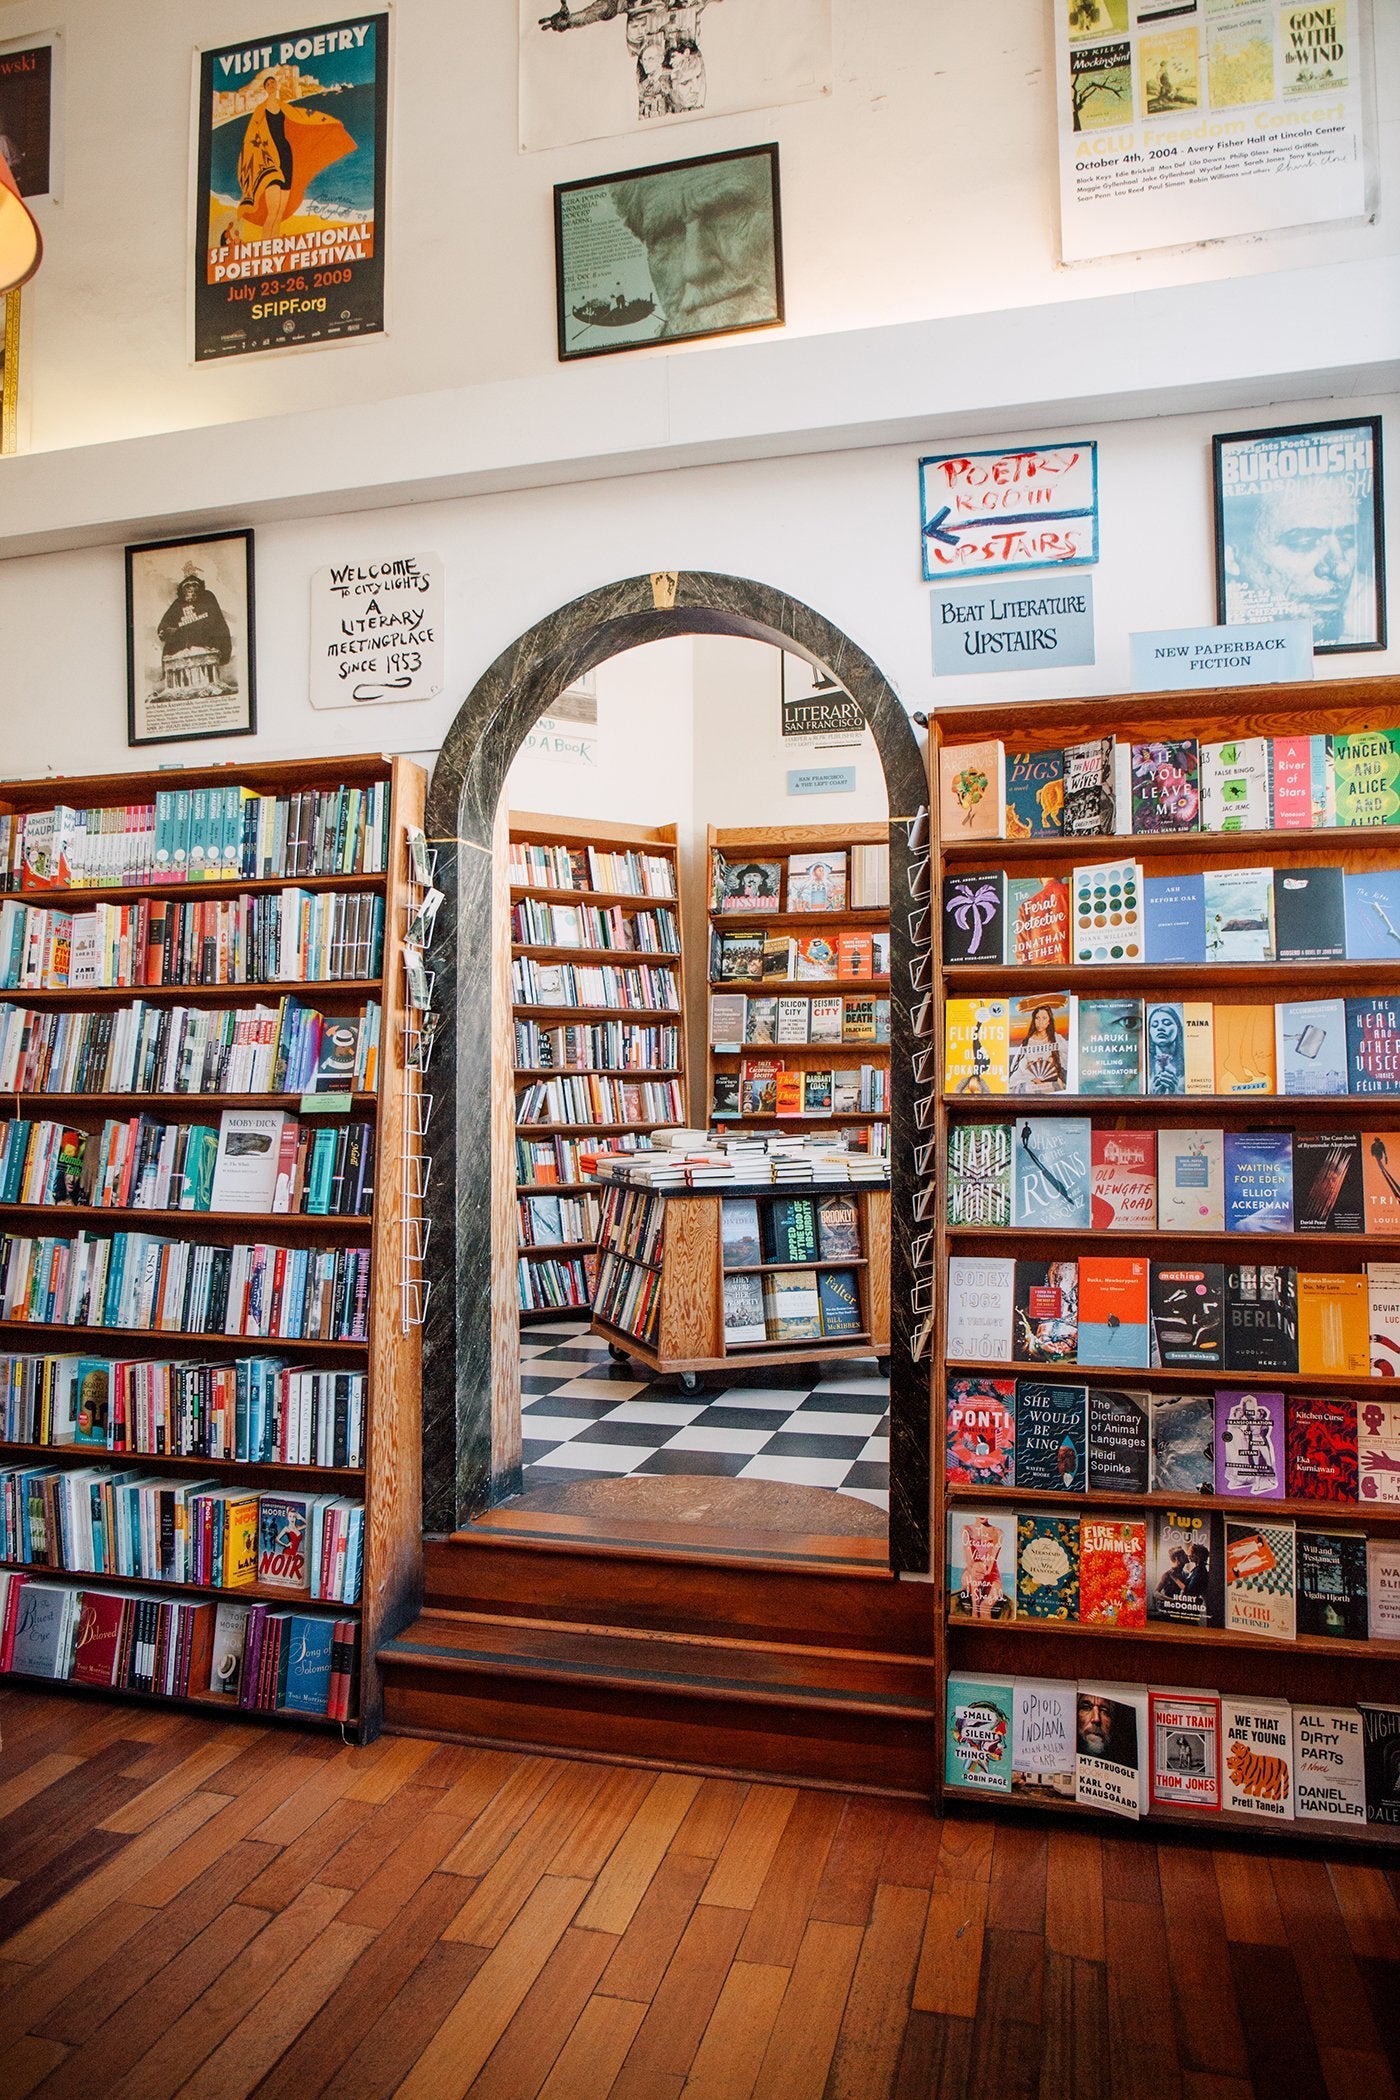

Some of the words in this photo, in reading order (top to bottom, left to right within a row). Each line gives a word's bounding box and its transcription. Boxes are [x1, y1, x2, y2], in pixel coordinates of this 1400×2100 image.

[1290, 8, 1336, 31] GONE
[1290, 26, 1336, 48] WITH
[219, 47, 273, 77] VISIT
[281, 26, 370, 65] POETRY
[1077, 51, 1088, 59] TO
[1092, 46, 1114, 57] KILL
[1285, 52, 1298, 64] the
[1297, 44, 1344, 65] WIND
[1073, 51, 1130, 71] Mockingbird
[1076, 134, 1135, 158] ACLU
[1143, 117, 1246, 149] Freedom
[1254, 102, 1345, 130] Concert
[1075, 158, 1120, 171] October
[1123, 153, 1145, 163] 4th,
[1149, 147, 1178, 160] 2004
[1187, 145, 1214, 154] Avery
[1217, 139, 1244, 149] Fisher
[1247, 132, 1266, 144] Hall
[1281, 128, 1312, 140] Lincoln
[1315, 126, 1346, 136] Center
[210, 246, 230, 265] SF
[234, 223, 371, 261] INTERNATIONAL
[215, 256, 286, 283] POETRY
[290, 242, 367, 271] FESTIVAL
[227, 284, 257, 303] July
[261, 277, 310, 297] 23-26,
[313, 269, 353, 289] 2009
[251, 297, 328, 321] SFIPF.org
[1280, 440, 1310, 448] Poets
[1223, 440, 1373, 484] BUKOWSKI
[936, 453, 1079, 488] POETRY
[956, 484, 1058, 512] ROOM
[934, 531, 1082, 566] UPSTAIRS
[330, 558, 420, 584] WELCOME
[355, 583, 382, 596] CITY
[384, 573, 431, 593] LIGHTS
[365, 598, 382, 616] A
[941, 603, 985, 625] BEAT
[990, 596, 1087, 621] LITERATURE
[341, 609, 425, 636] LITERARY
[328, 628, 435, 657] MEETINGPLACE
[963, 628, 1059, 656] UPSTAIRS
[1154, 646, 1189, 660] NEW
[1195, 638, 1287, 657] PAPERBACK
[338, 659, 377, 680] SINCE
[386, 652, 423, 673] 1953
[1190, 656, 1252, 671] FICTION
[785, 703, 862, 724] LITERARY
[785, 721, 804, 732] SAN
[806, 718, 863, 730] FRANCISCO
[1337, 740, 1395, 760] VINCENT
[1010, 760, 1060, 782] PIGS
[1082, 756, 1102, 770] NOT
[1233, 766, 1255, 775] BINGO
[1278, 761, 1305, 771] River
[1149, 767, 1182, 781] YOU
[1141, 783, 1192, 800] LEAVE
[1279, 787, 1306, 797] Stars
[1349, 778, 1387, 795] ALICE
[724, 896, 777, 909] MISSION
[1023, 894, 1058, 915] Feral
[1013, 912, 1066, 935] Detective
[1011, 931, 1066, 953] JONATHAN
[1021, 945, 1063, 962] LETHEM
[780, 1000, 806, 1008] SILICON
[846, 1002, 872, 1012] BLACK
[846, 1014, 873, 1023] DEATH
[949, 1026, 1004, 1041] FLIGHTS
[1090, 1034, 1129, 1043] HARUKI
[1082, 1044, 1138, 1053] MURAKAMI
[229, 1119, 278, 1127] MOBY-DICK
[1237, 1164, 1280, 1172] WAITING
[1234, 1176, 1255, 1184] FOR
[1259, 1176, 1285, 1184] EDEN
[1095, 1183, 1153, 1197] NEWGATE
[1242, 1189, 1278, 1198] ELLIOT
[1120, 1198, 1153, 1212] ROAD
[1232, 1202, 1289, 1210] ACKERMAN
[805, 1201, 814, 1247] ABSURDITY
[953, 1271, 1010, 1288] CODEX
[825, 1275, 857, 1305] Falter
[960, 1292, 1001, 1308] 1962
[951, 1334, 1007, 1359] SJÓN
[1023, 1396, 1050, 1408] SHE
[1092, 1400, 1110, 1409] The
[952, 1410, 1010, 1429] PONTI
[1030, 1411, 1080, 1425] WOULD
[1091, 1412, 1141, 1425] Dictionary
[1296, 1411, 1323, 1421] Kitchen
[1324, 1414, 1344, 1422] Curse
[1104, 1424, 1138, 1435] Animal
[1027, 1438, 1059, 1451] KING
[1091, 1434, 1145, 1448] Languages
[1091, 1451, 1115, 1460] Heidi
[1091, 1461, 1131, 1474] Sopinka
[1297, 1464, 1335, 1474] Kurniawan
[1166, 1512, 1203, 1528] Two
[1084, 1526, 1115, 1539] FIRE
[1084, 1537, 1142, 1553] SUMMER
[1303, 1545, 1317, 1554] Will
[259, 1551, 305, 1580] NOIR
[1303, 1591, 1325, 1601] Vigdis
[1326, 1594, 1351, 1603] Hjorth
[1242, 1607, 1275, 1622] GIRL
[76, 1607, 117, 1649] Beloved
[1232, 1617, 1270, 1629] RETURNED
[963, 1710, 992, 1721] SMALL
[1156, 1713, 1184, 1726] NIGHT
[1186, 1716, 1214, 1728] TRAIN
[1235, 1715, 1251, 1728] WE
[1253, 1718, 1279, 1731] THAT
[1021, 1720, 1066, 1742] INDIANA
[1299, 1715, 1325, 1728] ALL
[1331, 1719, 1358, 1734] THE
[965, 1729, 996, 1740] SILENT
[1228, 1728, 1248, 1740] ARE
[1251, 1731, 1286, 1746] YOUNG
[1301, 1731, 1339, 1745] DIRTY
[955, 1750, 990, 1760] THINGS
[1301, 1748, 1344, 1765] PARTS
[1080, 1757, 1091, 1766] MY
[1093, 1760, 1135, 1779] STRUGGLE
[964, 1774, 987, 1783] ROBIN
[988, 1777, 1007, 1786] PAGE
[1080, 1776, 1103, 1787] KARL
[1105, 1782, 1121, 1794] OVE
[1186, 1777, 1215, 1792] JONES
[1079, 1786, 1137, 1809] KNAUSGAARD
[1298, 1785, 1347, 1801] DANIEL
[1232, 1796, 1253, 1808] Preti
[1255, 1799, 1285, 1814] Taneja
[1301, 1800, 1364, 1817] HANDLER
